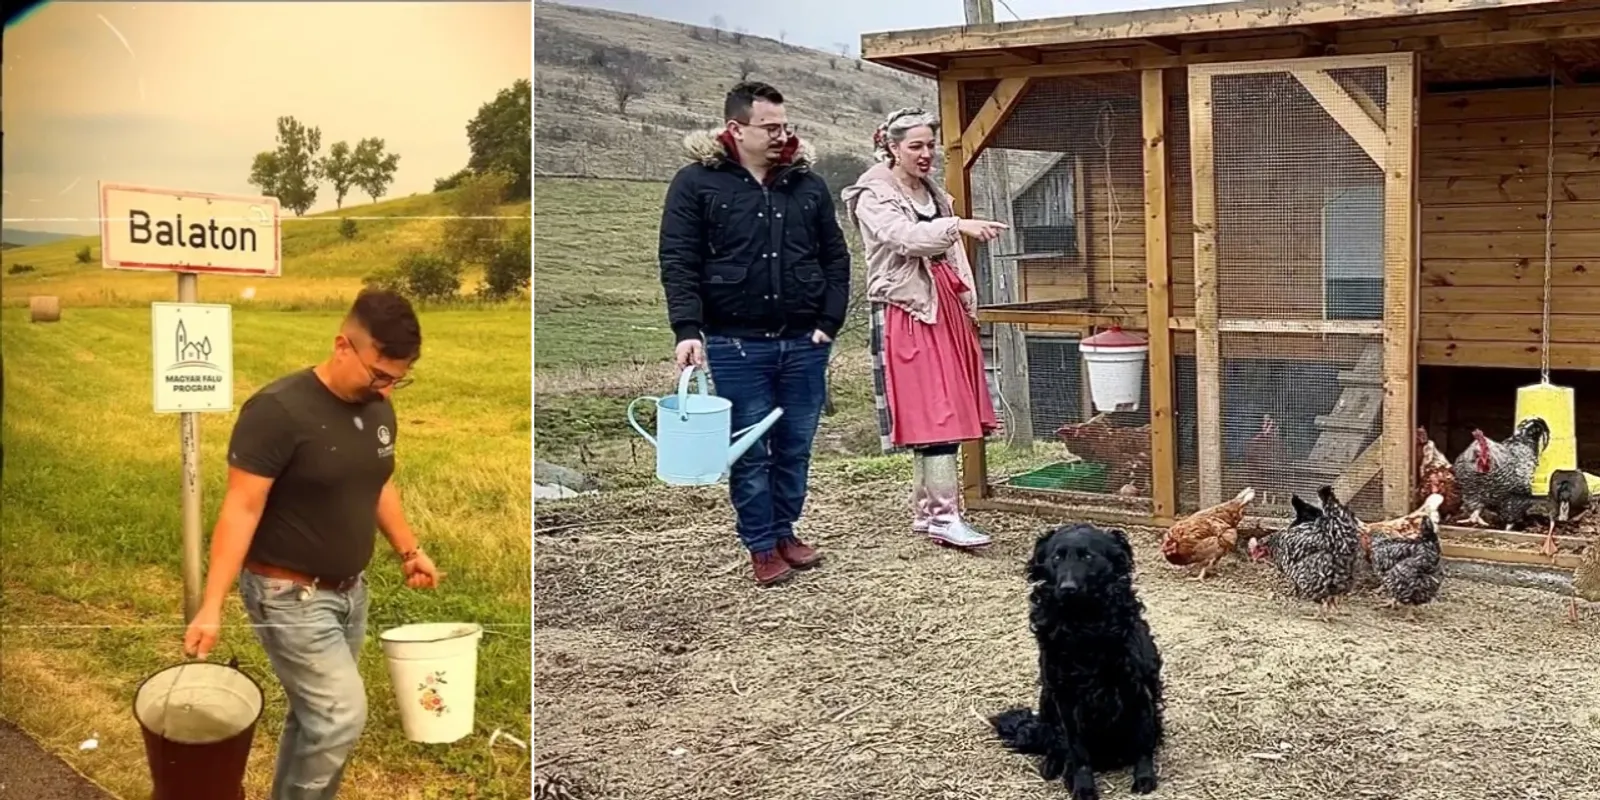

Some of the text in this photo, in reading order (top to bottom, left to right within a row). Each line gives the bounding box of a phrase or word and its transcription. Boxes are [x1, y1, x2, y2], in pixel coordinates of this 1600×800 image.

[129, 209, 256, 252] Balaton
[165, 375, 223, 383] MAGYAR FALU
[173, 384, 215, 392] PROGRAM
